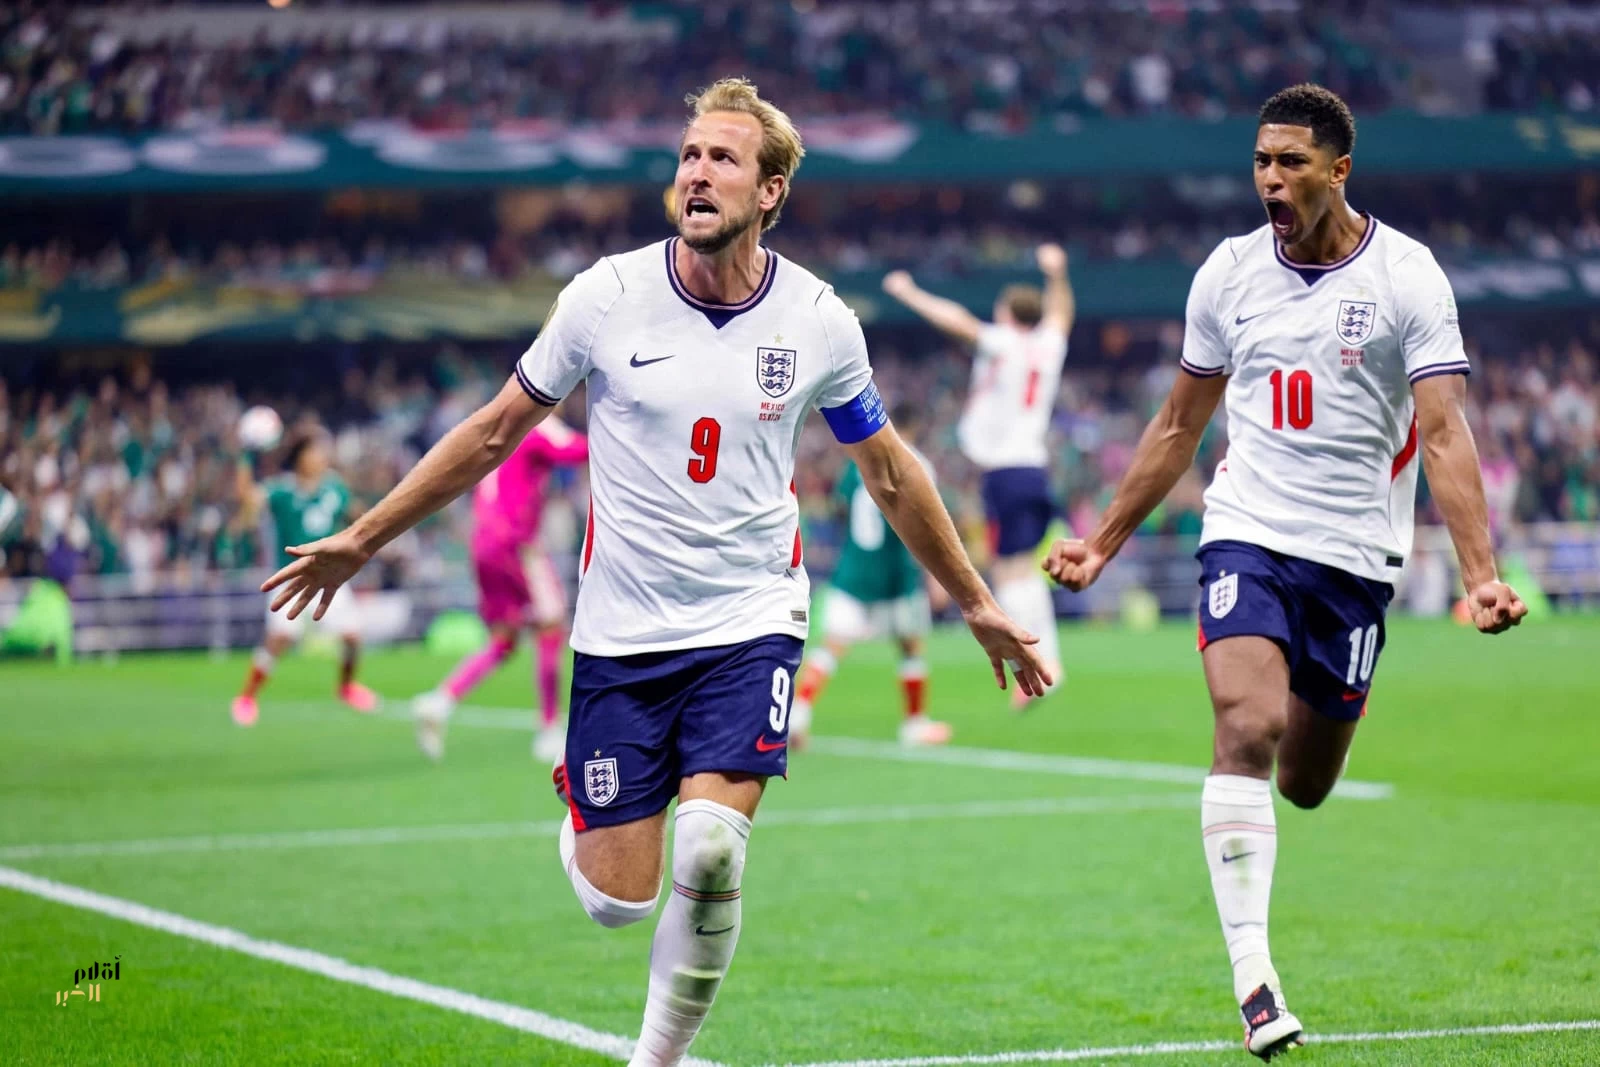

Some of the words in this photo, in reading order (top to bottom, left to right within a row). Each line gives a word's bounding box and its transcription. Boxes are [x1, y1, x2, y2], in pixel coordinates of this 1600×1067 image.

[760, 402, 785, 411] MEXICO
[1269, 369, 1313, 430] 10
[687, 416, 721, 484] 9
[1346, 623, 1378, 685] 10
[769, 666, 790, 733] 9
